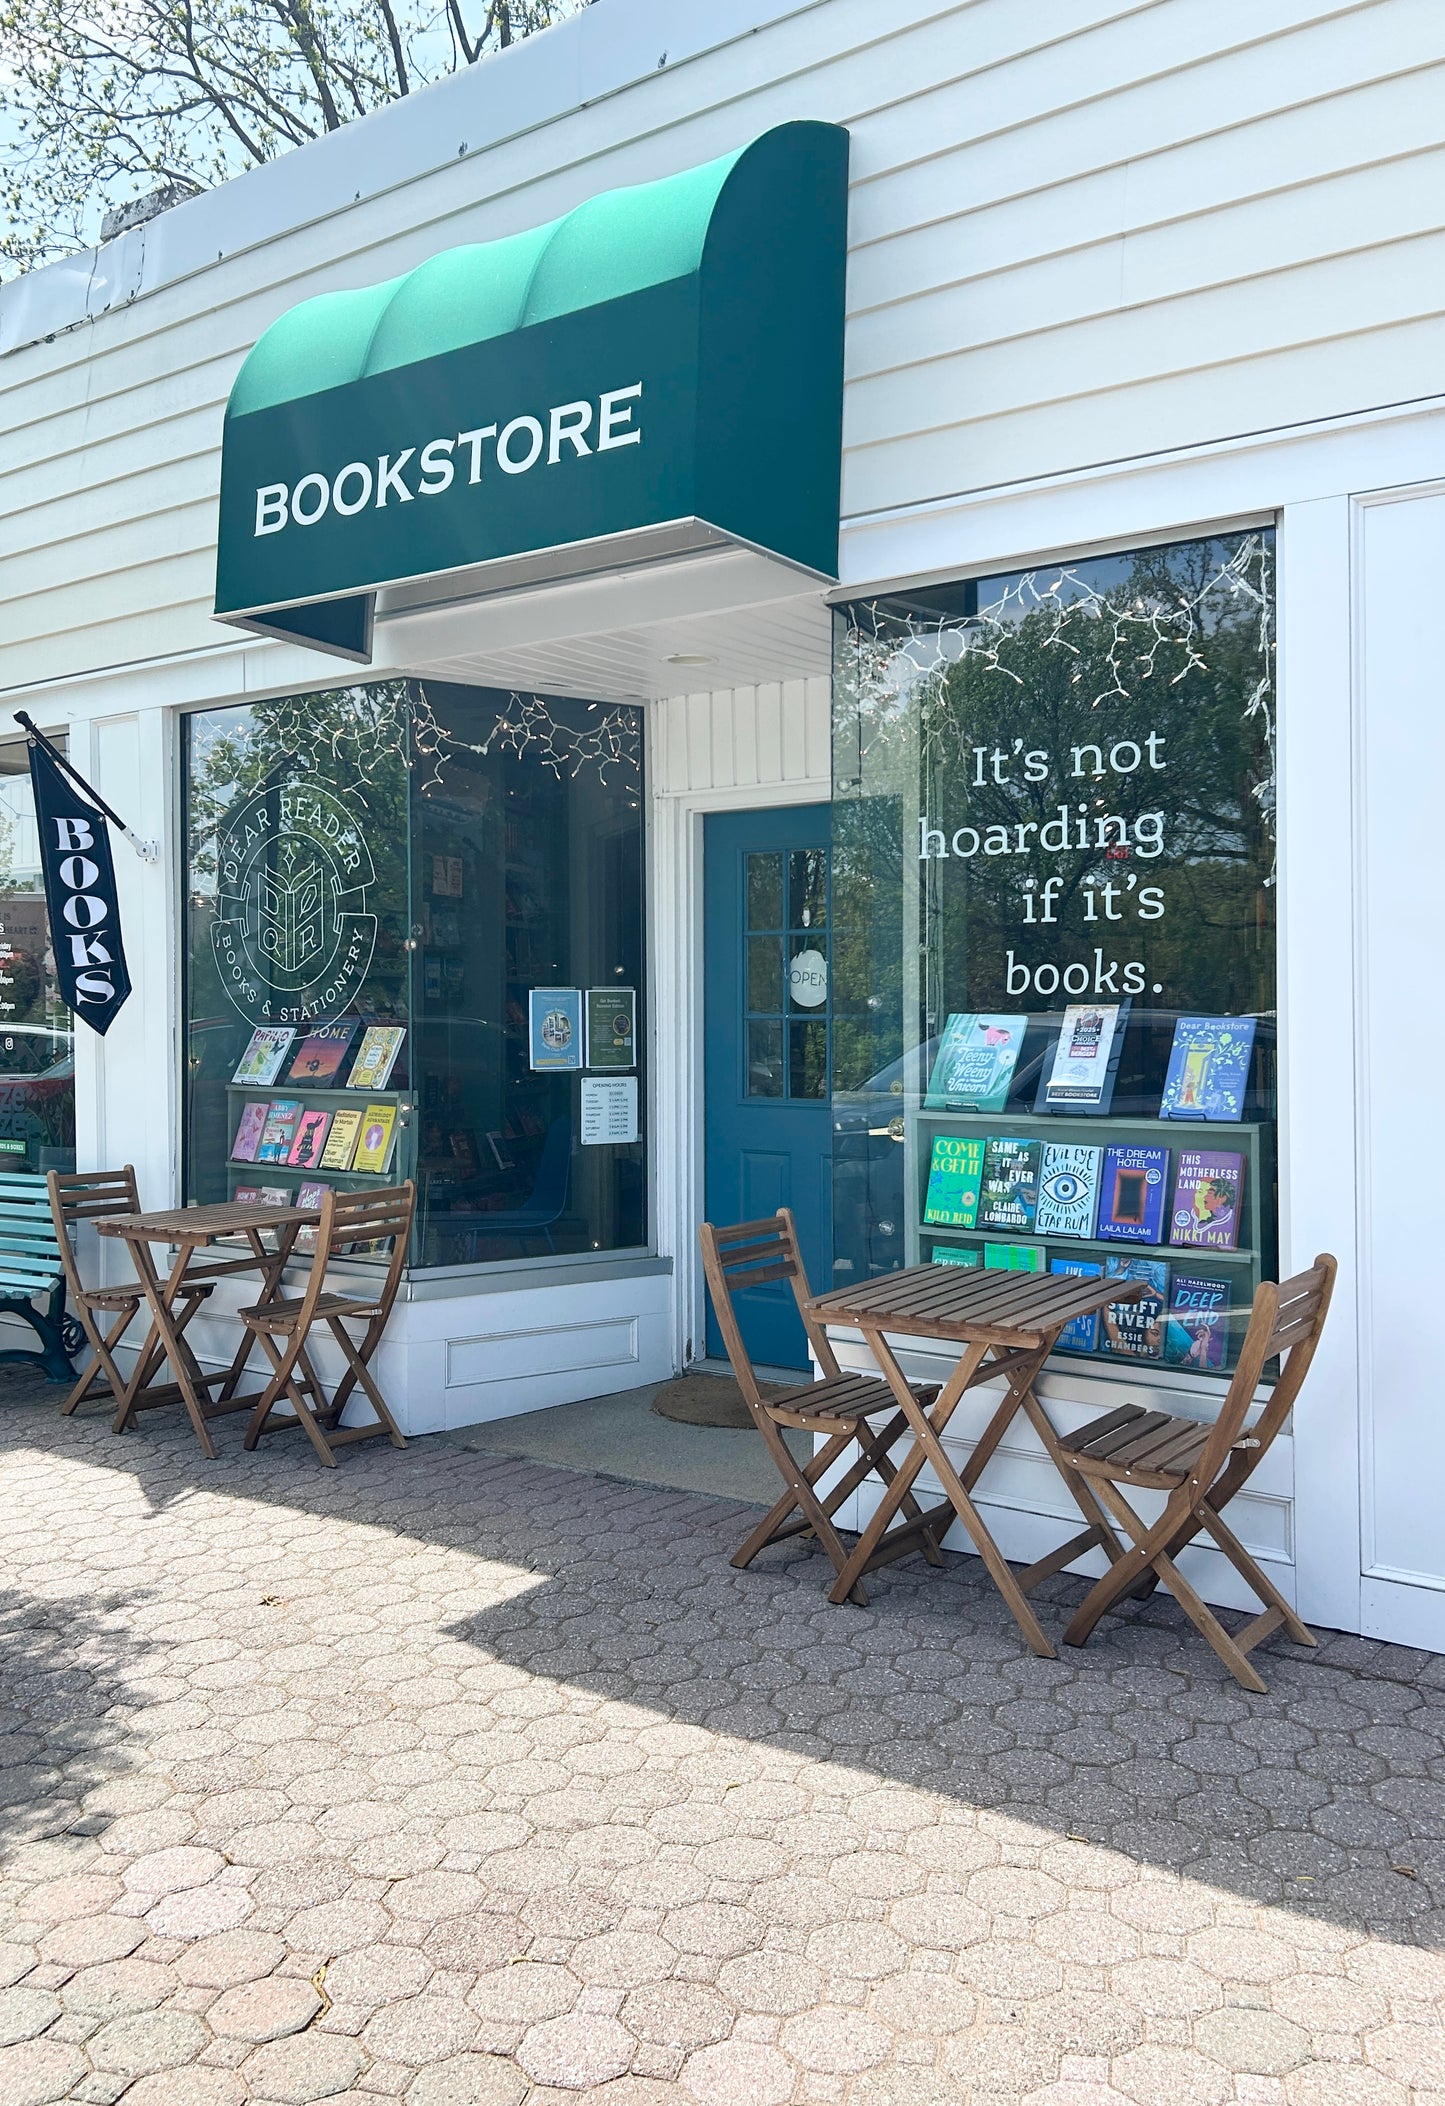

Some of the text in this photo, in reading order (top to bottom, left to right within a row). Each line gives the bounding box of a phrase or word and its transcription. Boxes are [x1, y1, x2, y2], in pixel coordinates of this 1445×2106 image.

[253, 380, 643, 538] BOOKSTORE
[1070, 729, 1167, 778] not
[918, 802, 1165, 860] hoarding
[223, 797, 361, 881] DEAR READER
[1022, 877, 1064, 924] if
[51, 816, 116, 1007] BOOKS
[222, 928, 364, 1022] BOOKS & STATIONERY
[1005, 947, 1164, 996] books.
[309, 1027, 350, 1040] HOME
[1180, 1022, 1250, 1031] Dear Bookstore
[953, 1062, 992, 1082] Weeny
[947, 1077, 987, 1093] Unicorn
[935, 1139, 980, 1159] COME
[992, 1140, 1019, 1154] SAME
[1107, 1147, 1162, 1160] THE DREAM
[1002, 1158, 1011, 1168] IT
[1017, 1151, 1030, 1163] AS
[1074, 1148, 1096, 1171] EYE
[1116, 1157, 1148, 1169] HOTEL
[1181, 1154, 1201, 1165] THIS
[1009, 1170, 1034, 1184] EVER
[1179, 1167, 1239, 1180] MOTHERLESS
[988, 1179, 1011, 1194] WAS
[1178, 1178, 1201, 1190] LAND
[992, 1201, 1021, 1213] CLAIRE
[927, 1209, 973, 1224] KILEY REID
[984, 1211, 1028, 1225] LOMBARDO
[1066, 1212, 1090, 1231] RUM
[1100, 1223, 1121, 1234] LAILA
[1122, 1224, 1151, 1236] LALAMI
[1172, 1228, 1231, 1245] NIKKI MAY
[1187, 1279, 1226, 1289] HAZELWOOD
[1174, 1289, 1224, 1310] DEEP
[1108, 1311, 1155, 1329] RIVER
[1182, 1309, 1220, 1327] END
[1117, 1331, 1143, 1342] ESSIE
[1104, 1340, 1154, 1354] CHAMBERS
